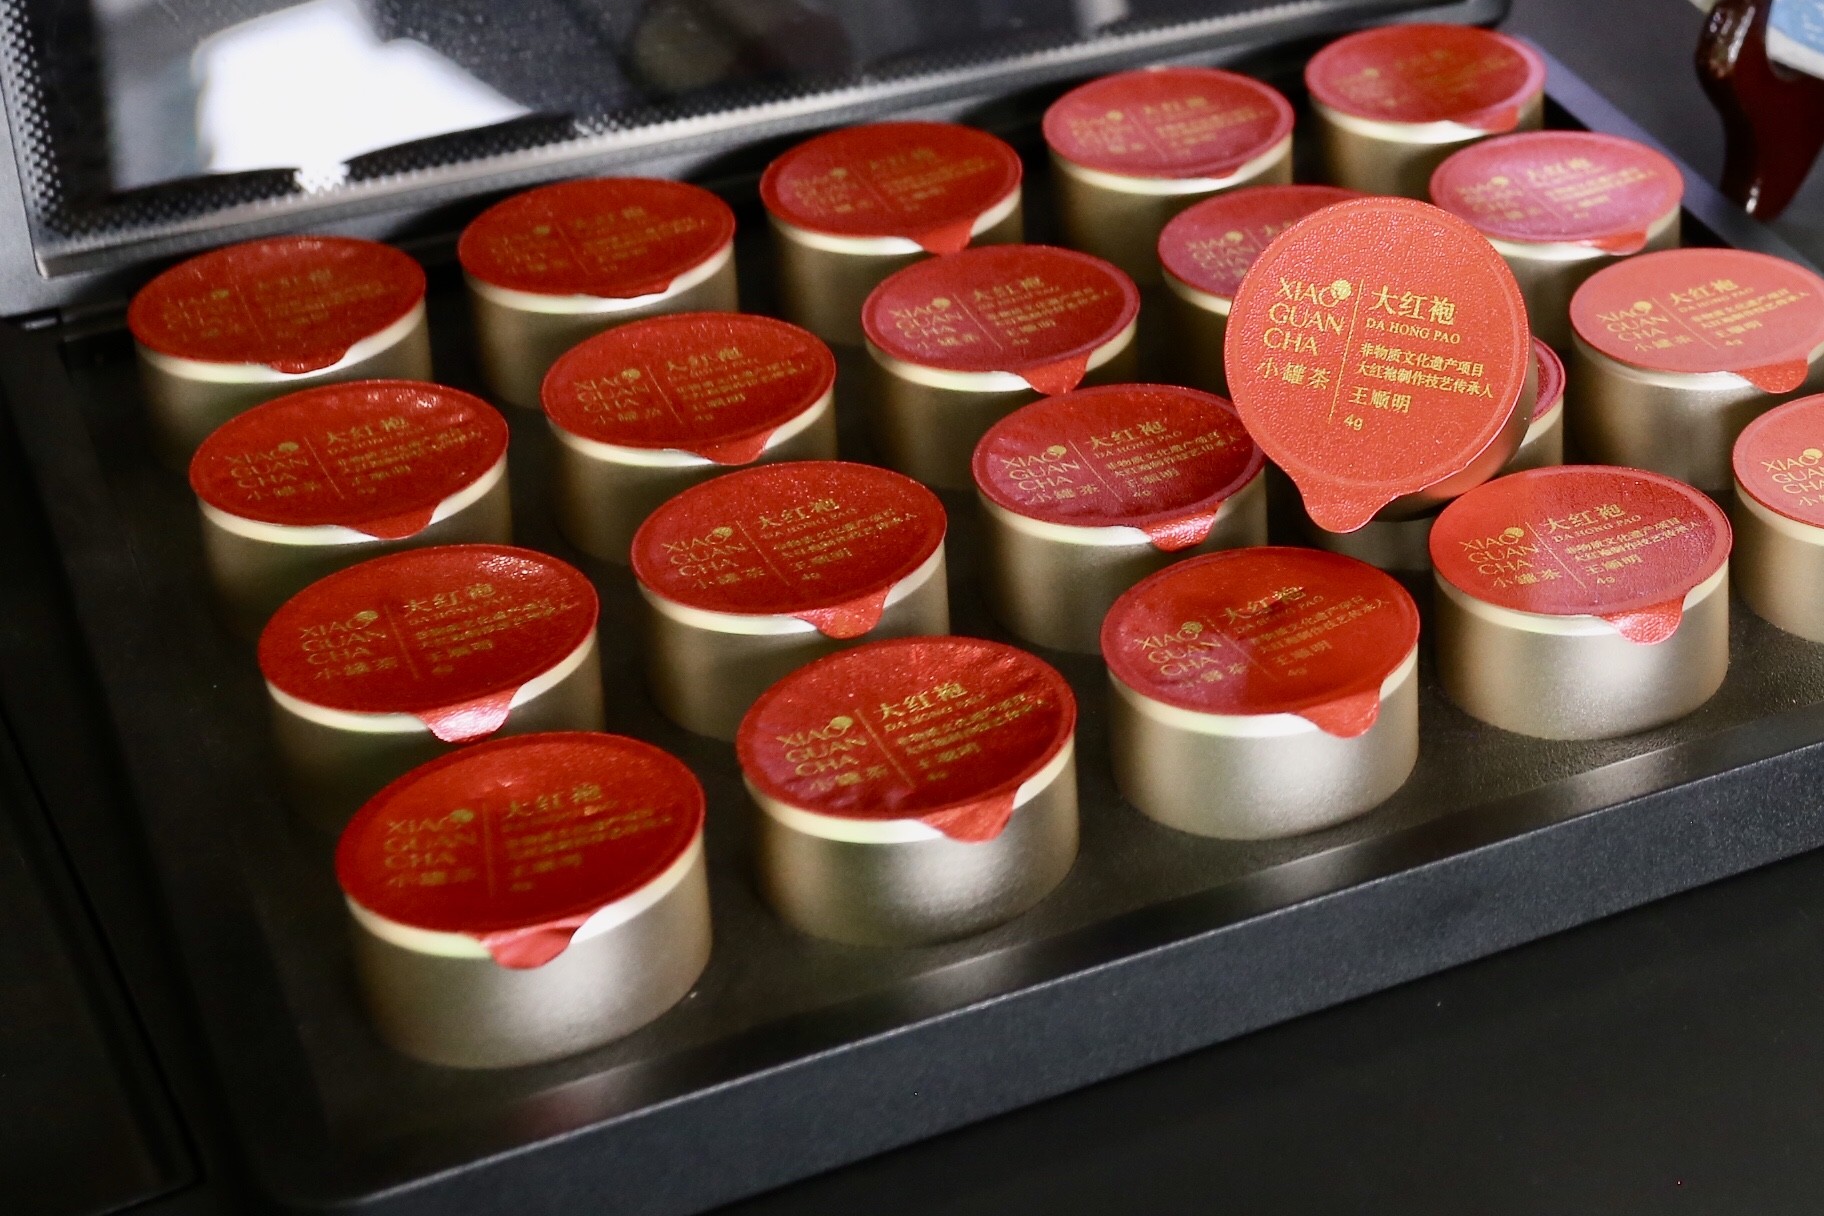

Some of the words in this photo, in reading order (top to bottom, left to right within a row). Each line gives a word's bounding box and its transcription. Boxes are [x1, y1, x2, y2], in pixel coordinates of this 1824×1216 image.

[1276, 276, 1340, 308] XIAO
[1368, 284, 1456, 326] 大红袍
[1268, 302, 1345, 335] GUAN
[1606, 316, 1669, 333] GUAN
[1263, 327, 1319, 356] CHA
[1365, 318, 1386, 333] DA
[1389, 321, 1430, 341] HONG
[1432, 329, 1461, 345] PAO
[1618, 328, 1666, 342] CHA
[1360, 342, 1485, 378] 非物质文化遗产项目
[1256, 356, 1330, 391] 小罐茶
[1355, 360, 1494, 399] 大红袍制作技艺传承人
[1348, 385, 1412, 414] 王顺明
[1344, 414, 1364, 431] 4g
[1086, 421, 1168, 451] 大红袍
[1010, 460, 1081, 481] GUAN
[1760, 453, 1820, 473] XIAO
[1018, 476, 1073, 491] CHA
[1539, 503, 1627, 534] 大红袍
[1616, 514, 1642, 528] PAO
[1458, 532, 1520, 553] XIAO
[1468, 543, 1539, 564] GUAN
[1478, 558, 1534, 576] CHA
[1148, 639, 1223, 664] GUAN
[1160, 656, 1218, 676] CHA
